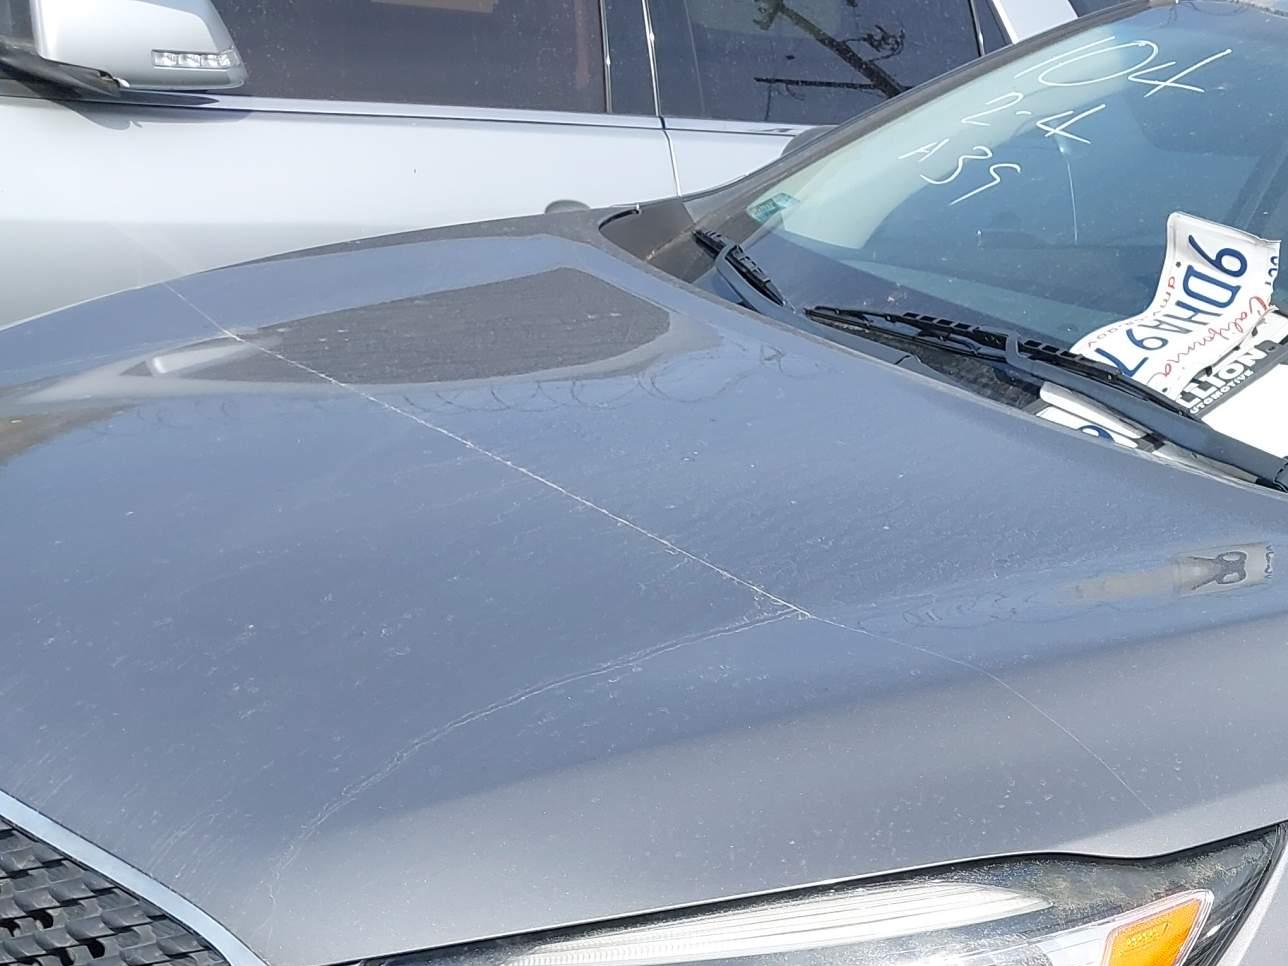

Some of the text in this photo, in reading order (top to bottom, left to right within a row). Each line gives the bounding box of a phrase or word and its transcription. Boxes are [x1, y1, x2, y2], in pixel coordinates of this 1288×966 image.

[1094, 234, 1248, 378] 9DHA97
[1146, 295, 1268, 385] California
[1175, 343, 1268, 409] LLION
[1189, 369, 1255, 415] UTOMOTIVE
